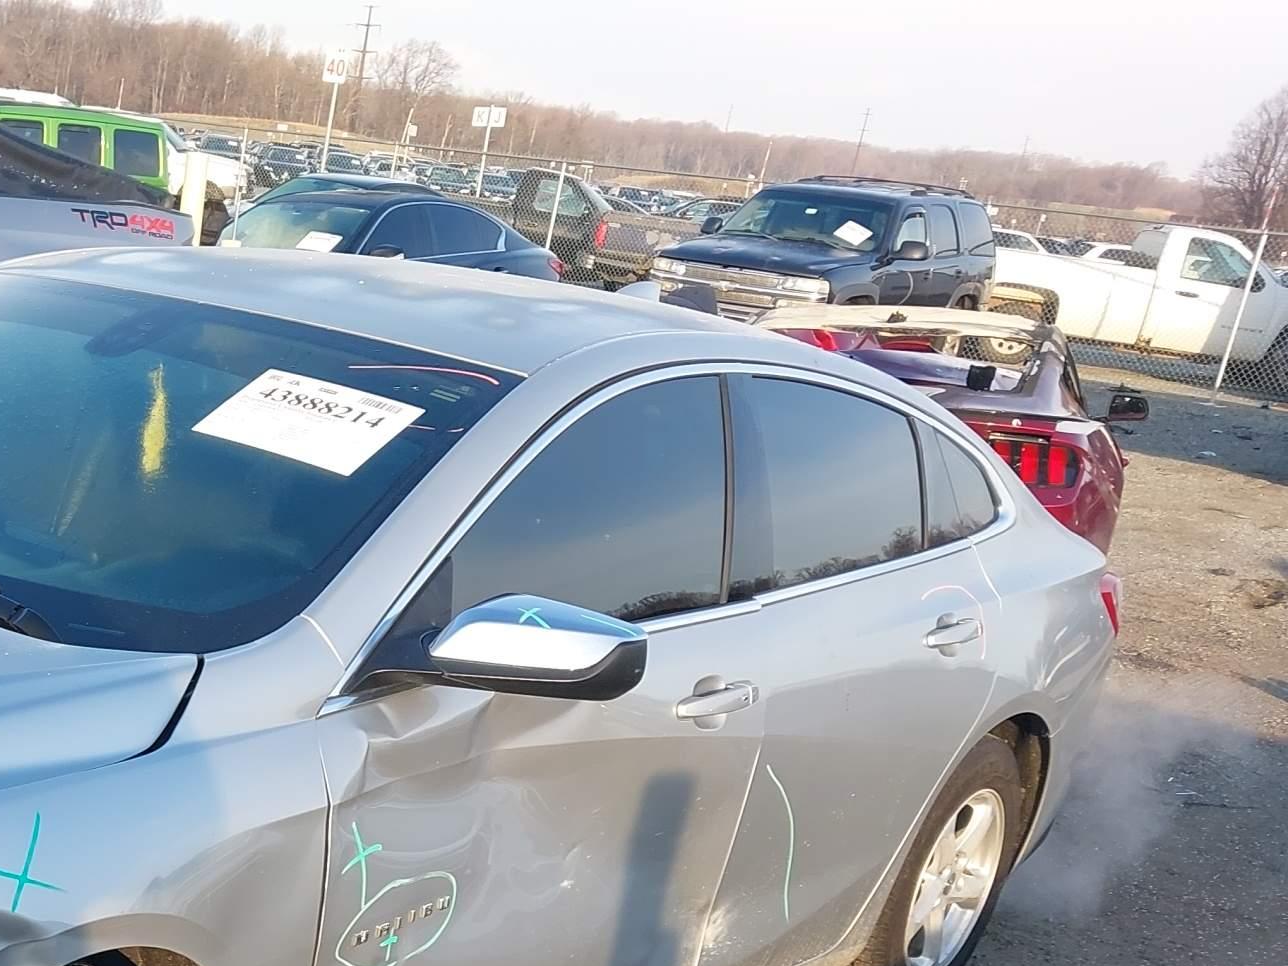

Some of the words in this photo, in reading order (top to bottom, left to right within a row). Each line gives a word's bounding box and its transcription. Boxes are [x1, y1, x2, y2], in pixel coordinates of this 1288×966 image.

[327, 58, 345, 77] 40
[476, 110, 486, 122] K
[494, 111, 502, 124] J
[259, 387, 386, 428] 43888214
